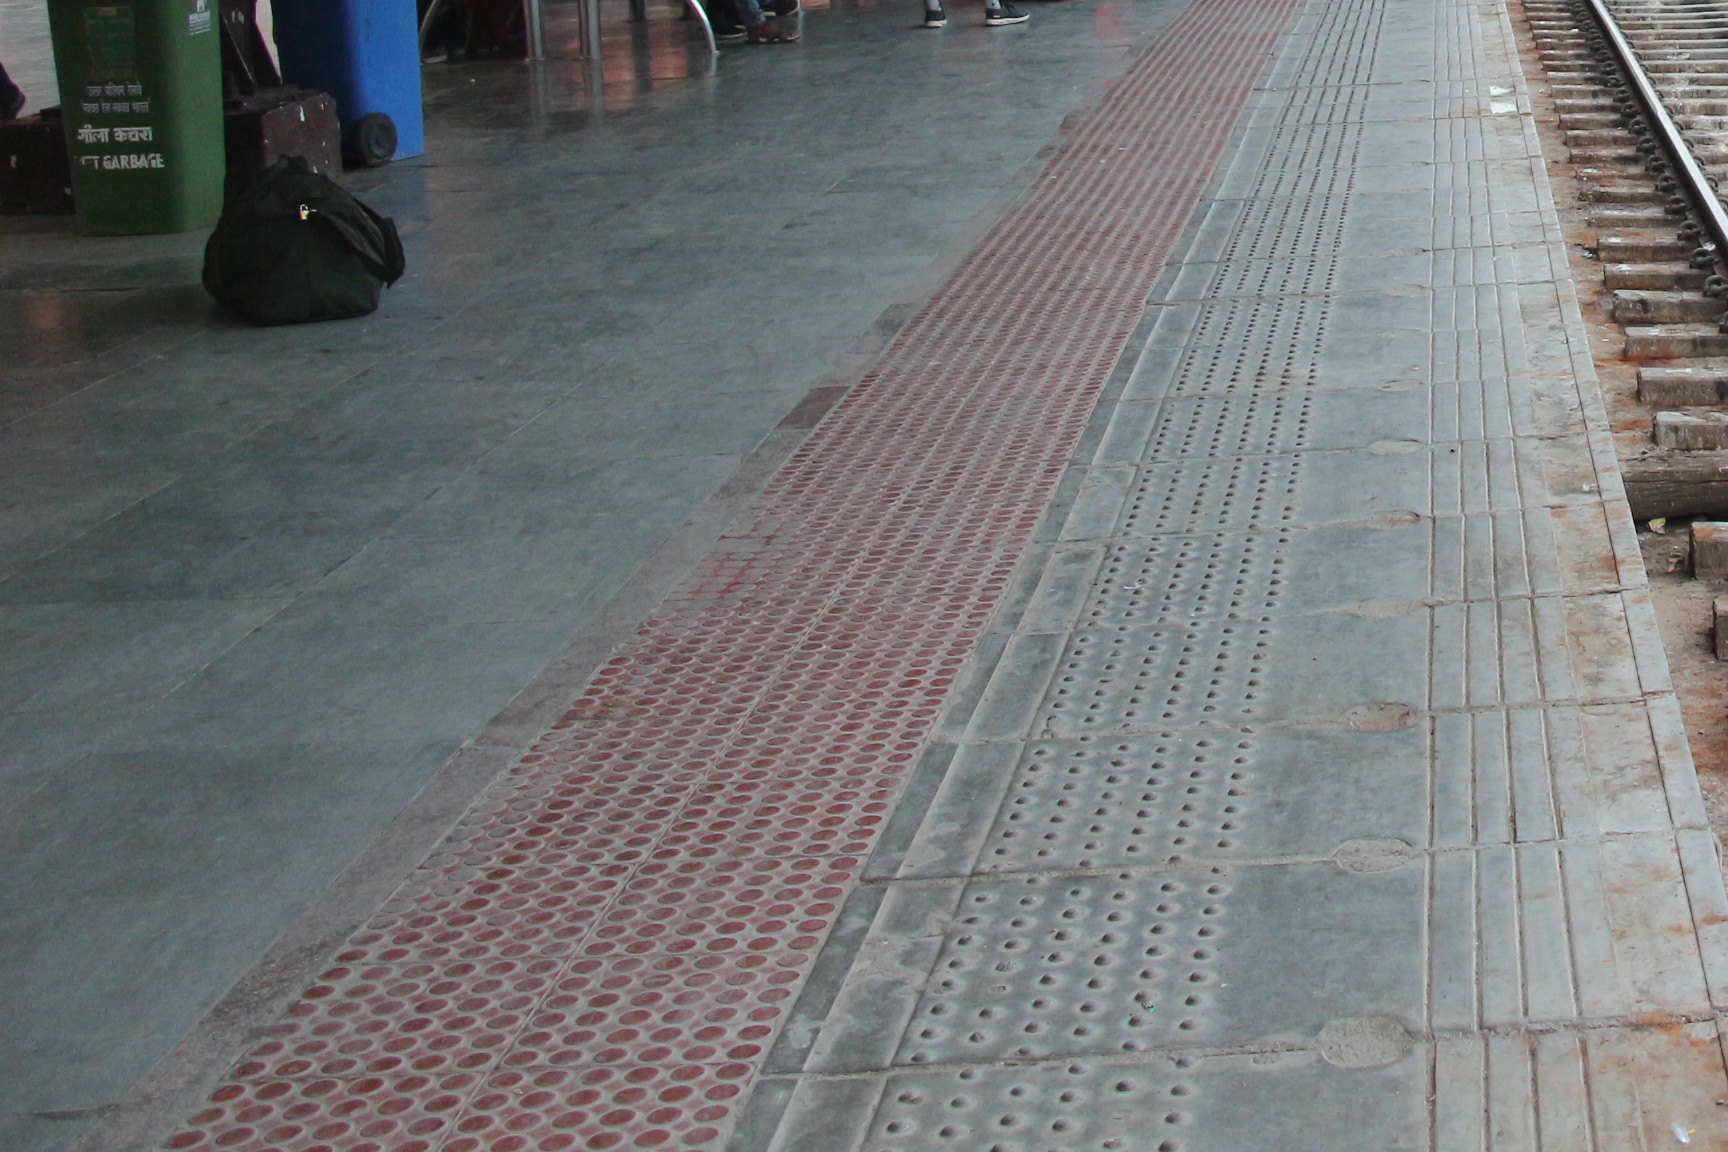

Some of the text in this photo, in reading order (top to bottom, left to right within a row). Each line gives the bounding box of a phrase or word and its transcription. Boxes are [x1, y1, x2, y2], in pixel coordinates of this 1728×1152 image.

[77, 123, 153, 144] गीला कचरा
[102, 152, 165, 170] GARBAGE
